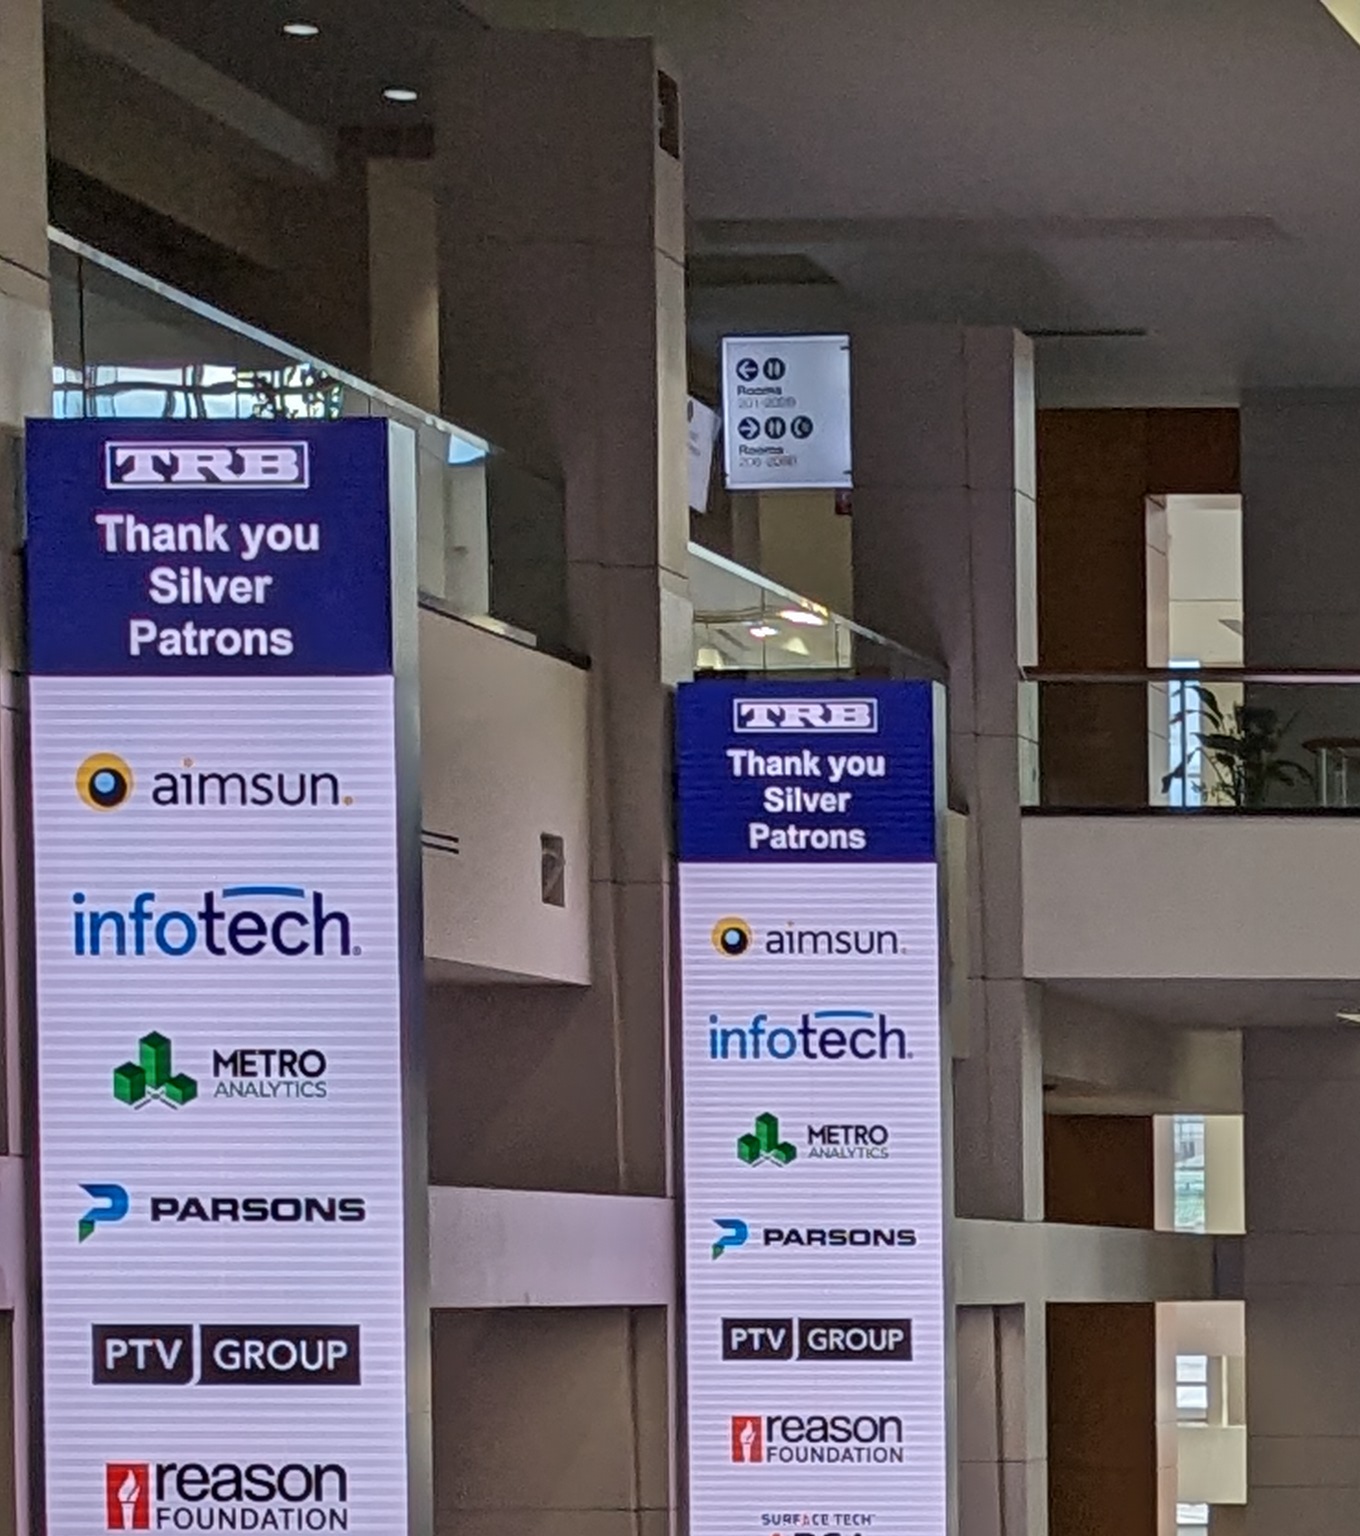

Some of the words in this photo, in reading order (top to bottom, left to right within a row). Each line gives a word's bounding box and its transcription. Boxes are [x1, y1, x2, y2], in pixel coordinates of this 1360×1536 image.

[737, 385, 783, 396] Rooms
[114, 446, 300, 484] TRB
[97, 514, 228, 552] Thank
[241, 522, 320, 560] you
[149, 567, 273, 605] Silver
[129, 620, 293, 657] Patrons
[741, 704, 871, 726] TRB
[726, 749, 820, 776] Thank
[829, 755, 885, 782] you
[763, 787, 851, 812] Silver
[749, 823, 866, 849] Patrons
[72, 887, 351, 957] infotech
[710, 1013, 906, 1059] infotech
[212, 1049, 327, 1078] METRO
[213, 1080, 327, 1099] ANALYTICS
[807, 1125, 888, 1145] METRO
[808, 1147, 889, 1158] ANALYTICS
[151, 1198, 366, 1221] PARSONS
[764, 1229, 916, 1246] PARSONS
[731, 1329, 786, 1350] PTV
[807, 1329, 904, 1350] GROUP
[105, 1339, 183, 1370] PTV
[213, 1340, 348, 1371] GROUP
[767, 1416, 902, 1442] reason
[767, 1448, 903, 1462] FOUNDATION
[156, 1463, 347, 1501] reason
[156, 1508, 347, 1530] FOUNDATION
[761, 1514, 829, 1525] SURFACE
[835, 1514, 871, 1525] TECH
